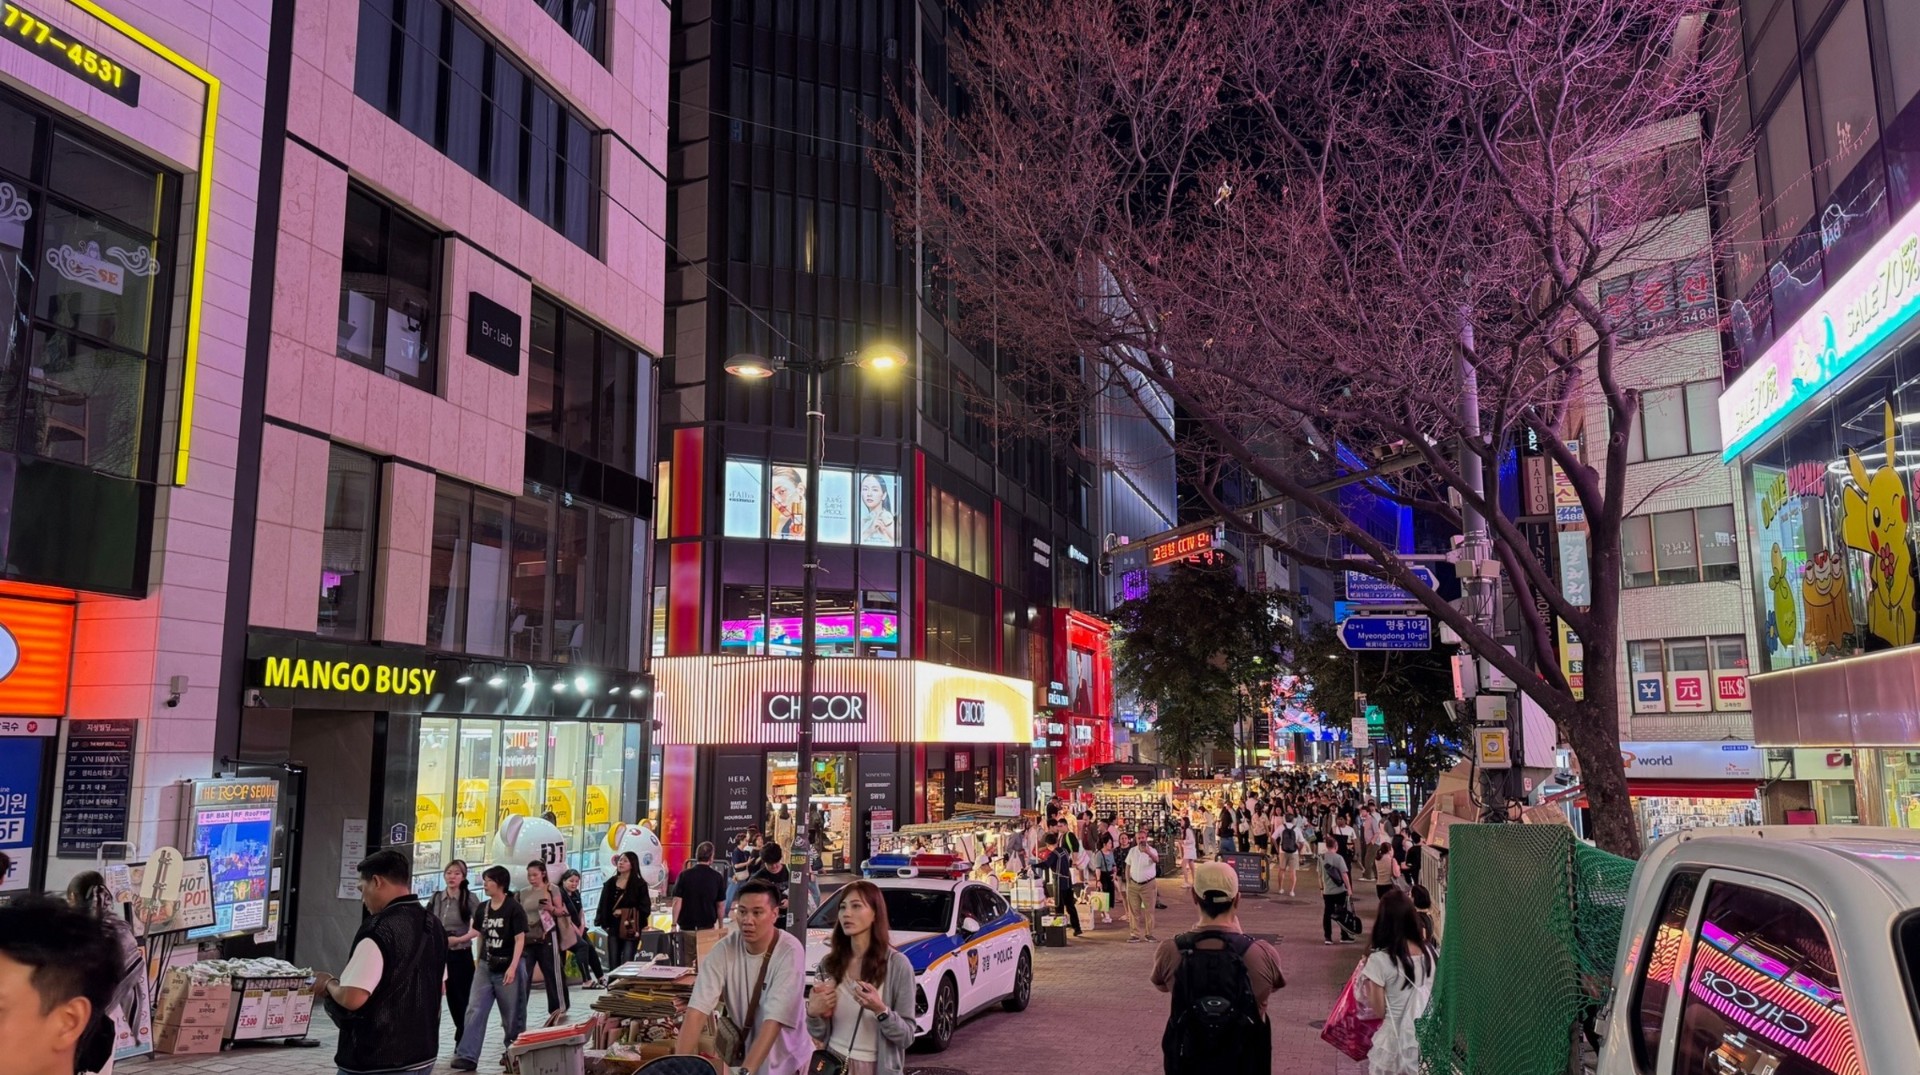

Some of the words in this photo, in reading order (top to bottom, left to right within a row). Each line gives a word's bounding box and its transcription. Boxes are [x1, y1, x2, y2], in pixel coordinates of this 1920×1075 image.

[4, 3, 122, 89] 777-4531
[1847, 284, 1880, 338] SALE
[481, 320, 513, 348] Br:lab
[1788, 462, 1826, 499] PICNIC
[1386, 620, 1428, 631] 명동10길
[1358, 632, 1405, 640] Myeongdong
[1408, 632, 1428, 640] 10-gil
[265, 656, 371, 693] MANGO
[375, 665, 437, 695] BUSY
[1680, 681, 1698, 698] 元
[1720, 680, 1745, 696] HK$
[768, 695, 864, 721] CHCOR
[0, 722, 19, 732] 국수
[1638, 755, 1673, 766] world
[727, 775, 751, 783] HERA
[250, 784, 276, 799] SEOUL
[178, 876, 204, 893] HOT
[183, 889, 207, 909] POT
[996, 946, 1013, 966] POLICE
